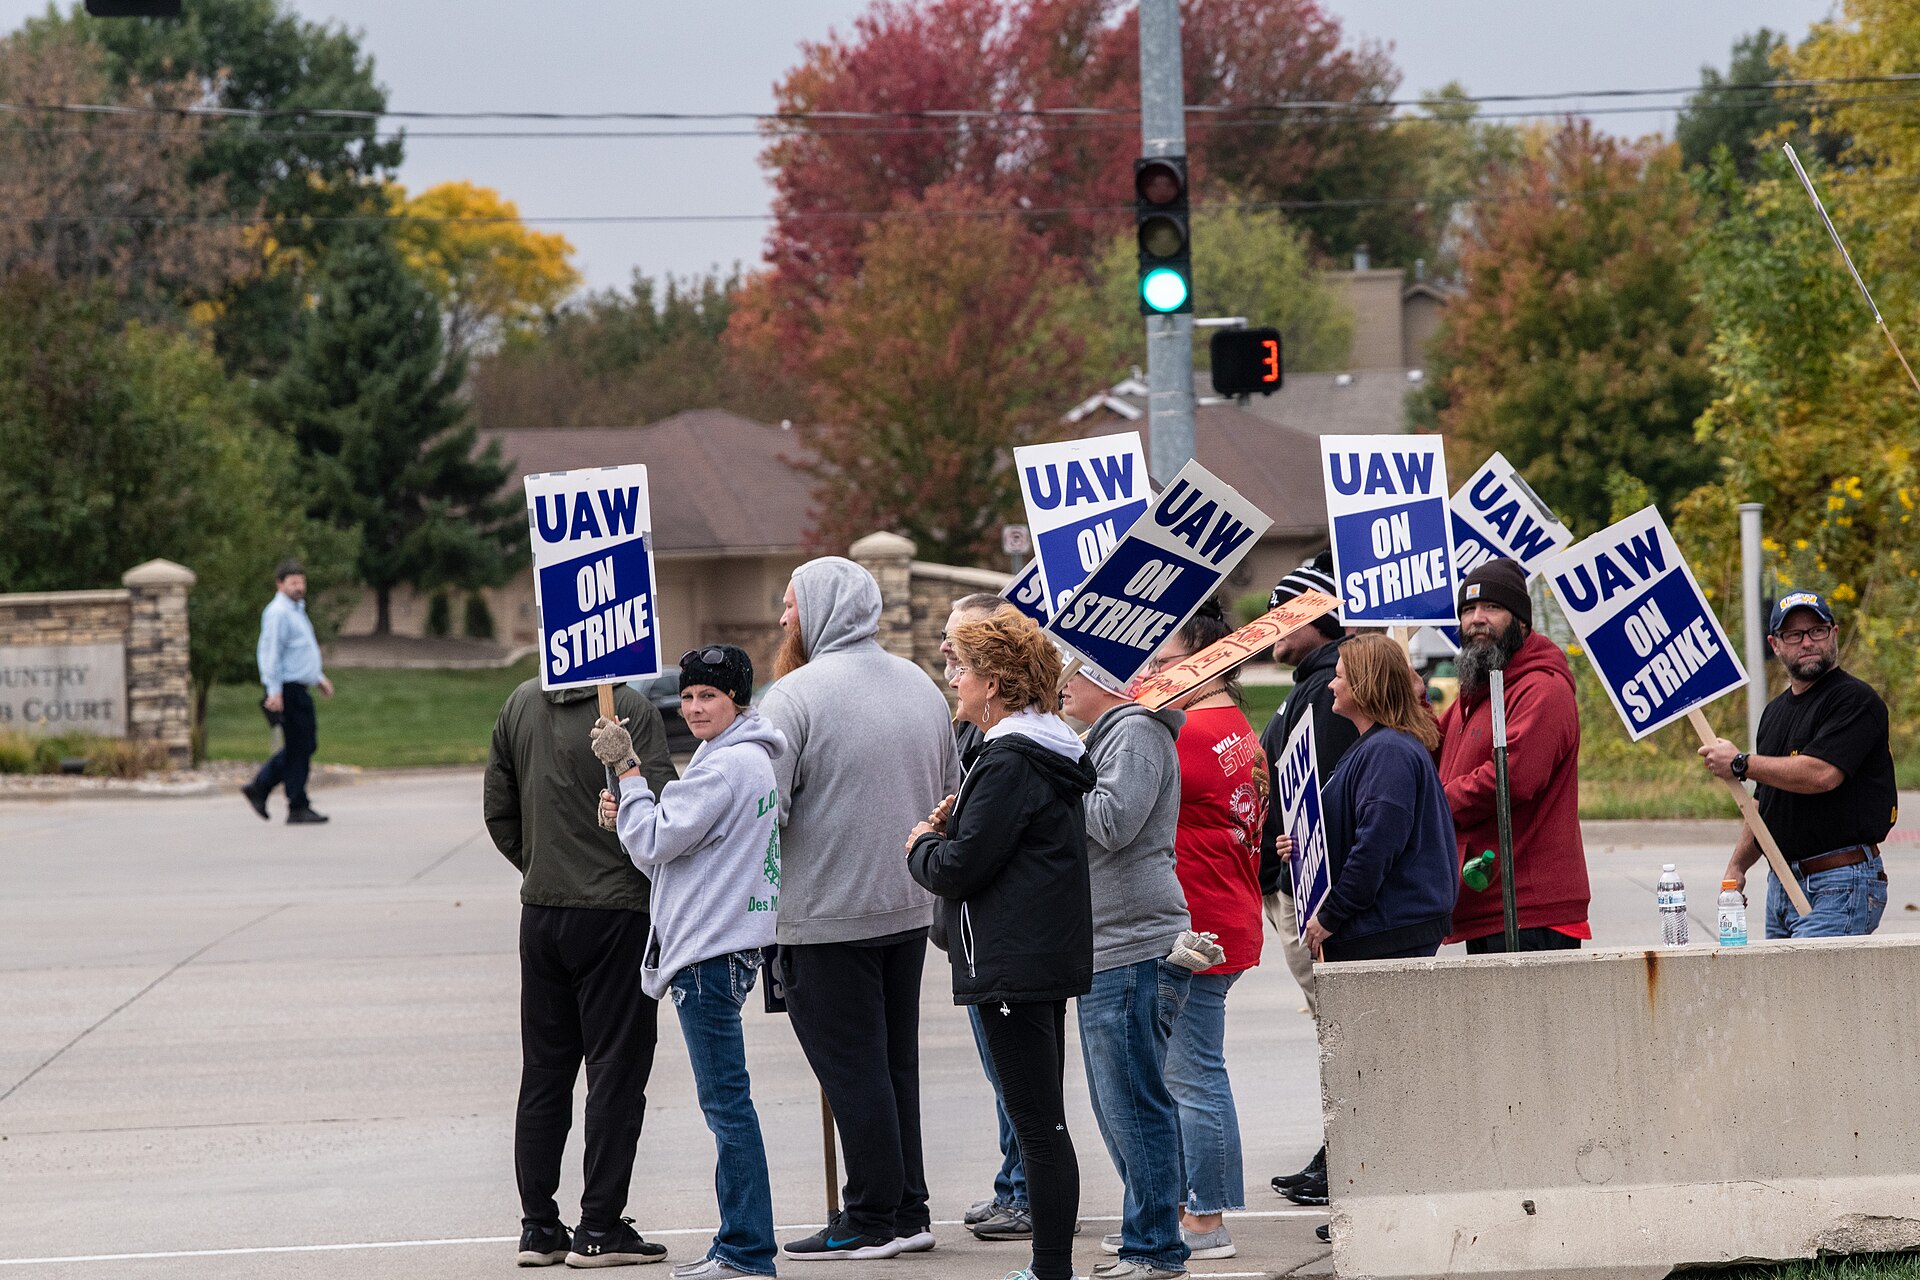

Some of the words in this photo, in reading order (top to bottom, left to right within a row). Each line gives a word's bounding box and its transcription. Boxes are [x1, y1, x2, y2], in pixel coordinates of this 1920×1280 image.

[1262, 340, 1278, 382] 3
[1025, 453, 1133, 510] UAW
[1329, 453, 1434, 495] UAW
[534, 486, 640, 543] UAW
[1154, 479, 1254, 566] UAW
[1371, 511, 1412, 560] ON
[1469, 469, 1556, 563] UAW
[1077, 519, 1118, 573] ON
[1455, 538, 1498, 576] ON
[1555, 526, 1667, 613] UAW
[577, 555, 616, 612] ON
[1123, 559, 1184, 602] ON
[1346, 547, 1447, 614] STRIKE
[550, 593, 650, 677] STRIKE
[1060, 592, 1177, 651] STRIKE
[1624, 597, 1672, 658] ON
[0, 665, 88, 688] UNTRY
[1621, 615, 1720, 723] STRIKE
[23, 697, 114, 722] COURT
[1211, 732, 1240, 755] WILL
[1281, 725, 1310, 812] UAW
[757, 787, 779, 818] LO
[1297, 798, 1310, 860] ON
[1297, 818, 1323, 927] STRIKE
[748, 896, 768, 912] Des
